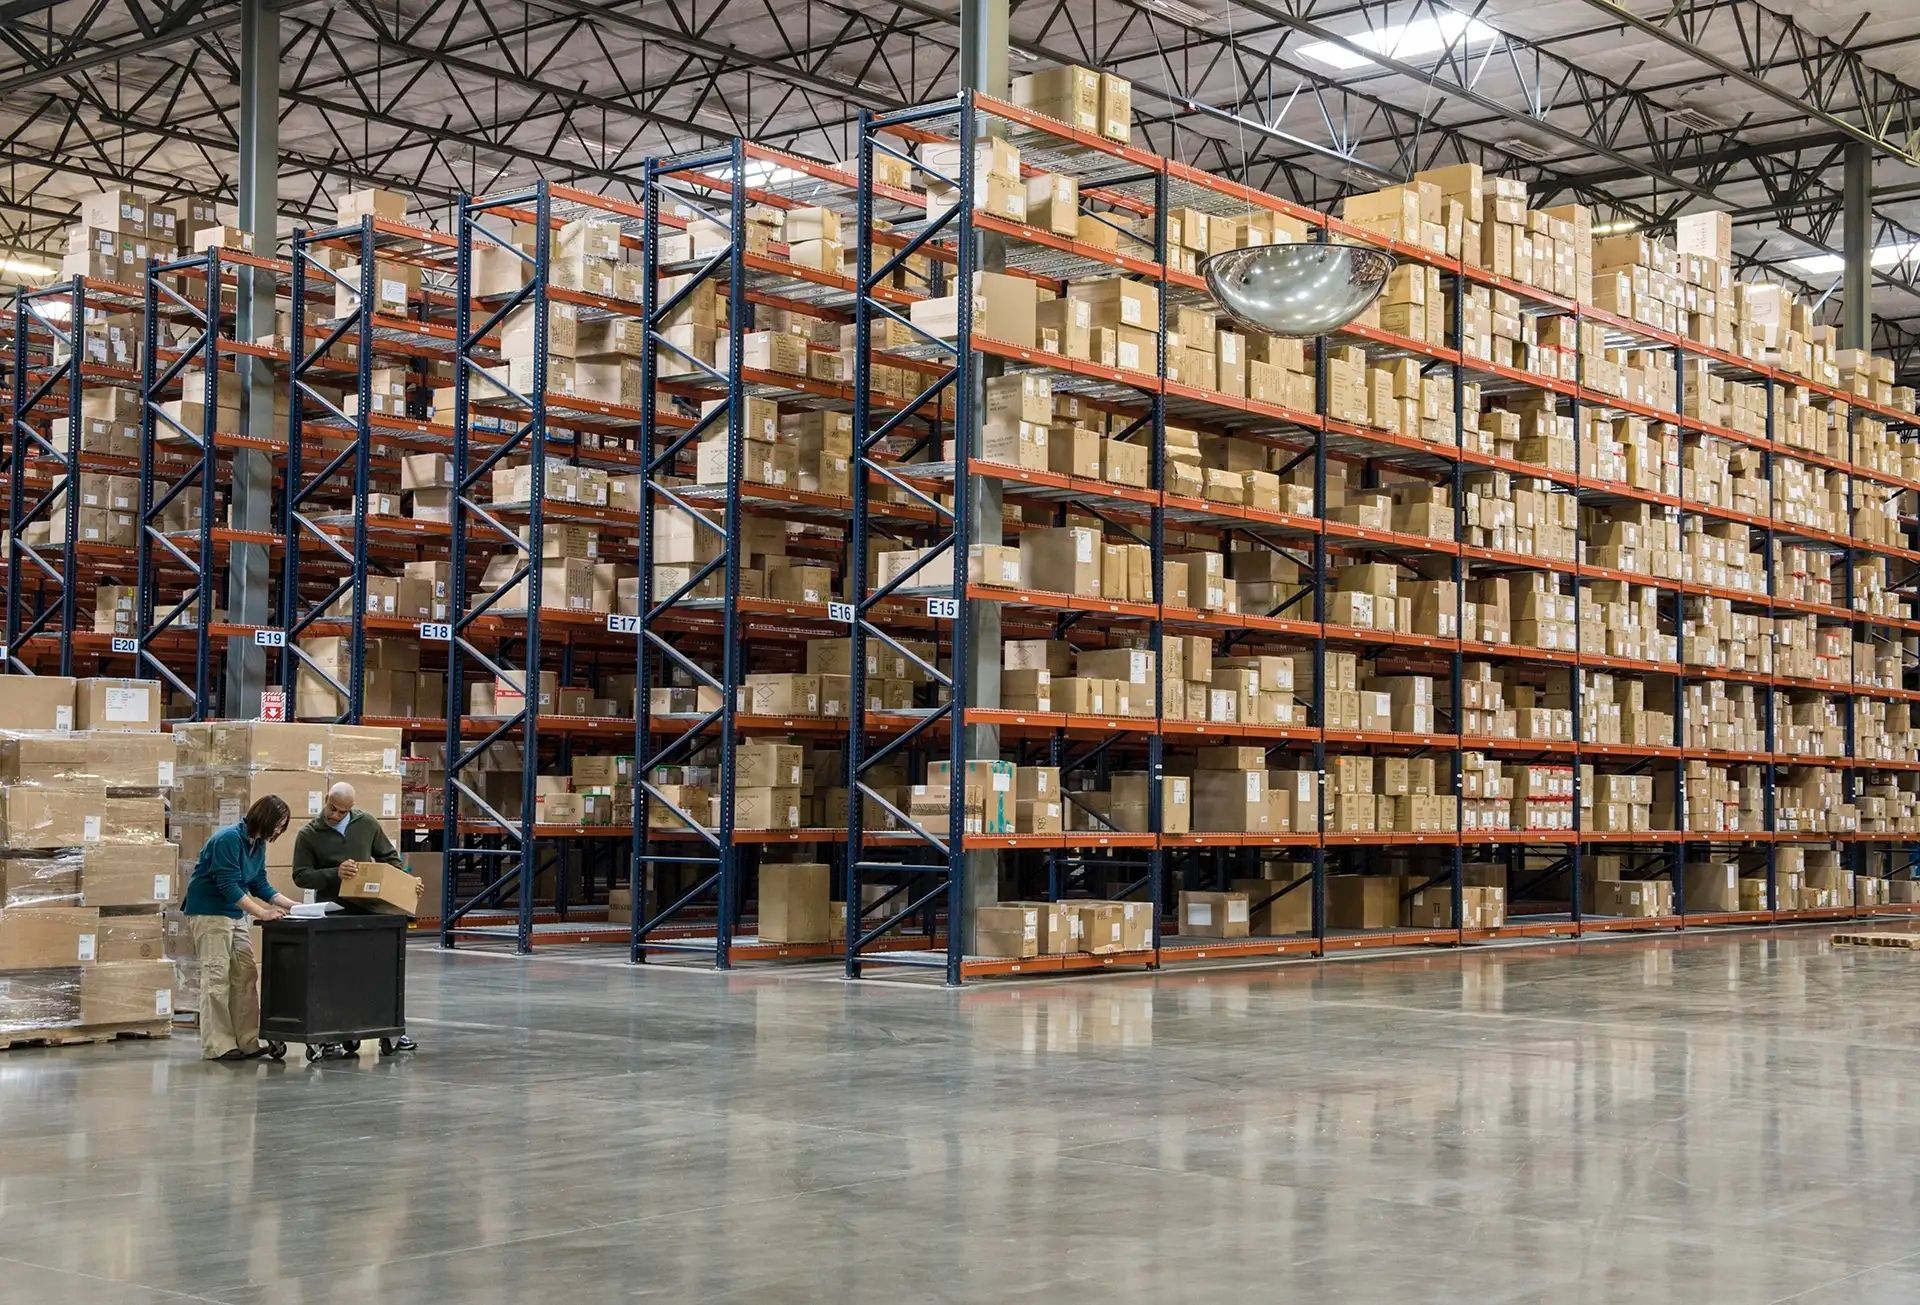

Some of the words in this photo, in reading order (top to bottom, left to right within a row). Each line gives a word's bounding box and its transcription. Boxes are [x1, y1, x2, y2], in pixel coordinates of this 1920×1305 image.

[830, 604, 850, 620] E16
[929, 600, 954, 616] E15
[610, 616, 636, 630] E17
[257, 632, 281, 644] E19
[423, 625, 448, 638] E18
[114, 639, 135, 651] E20
